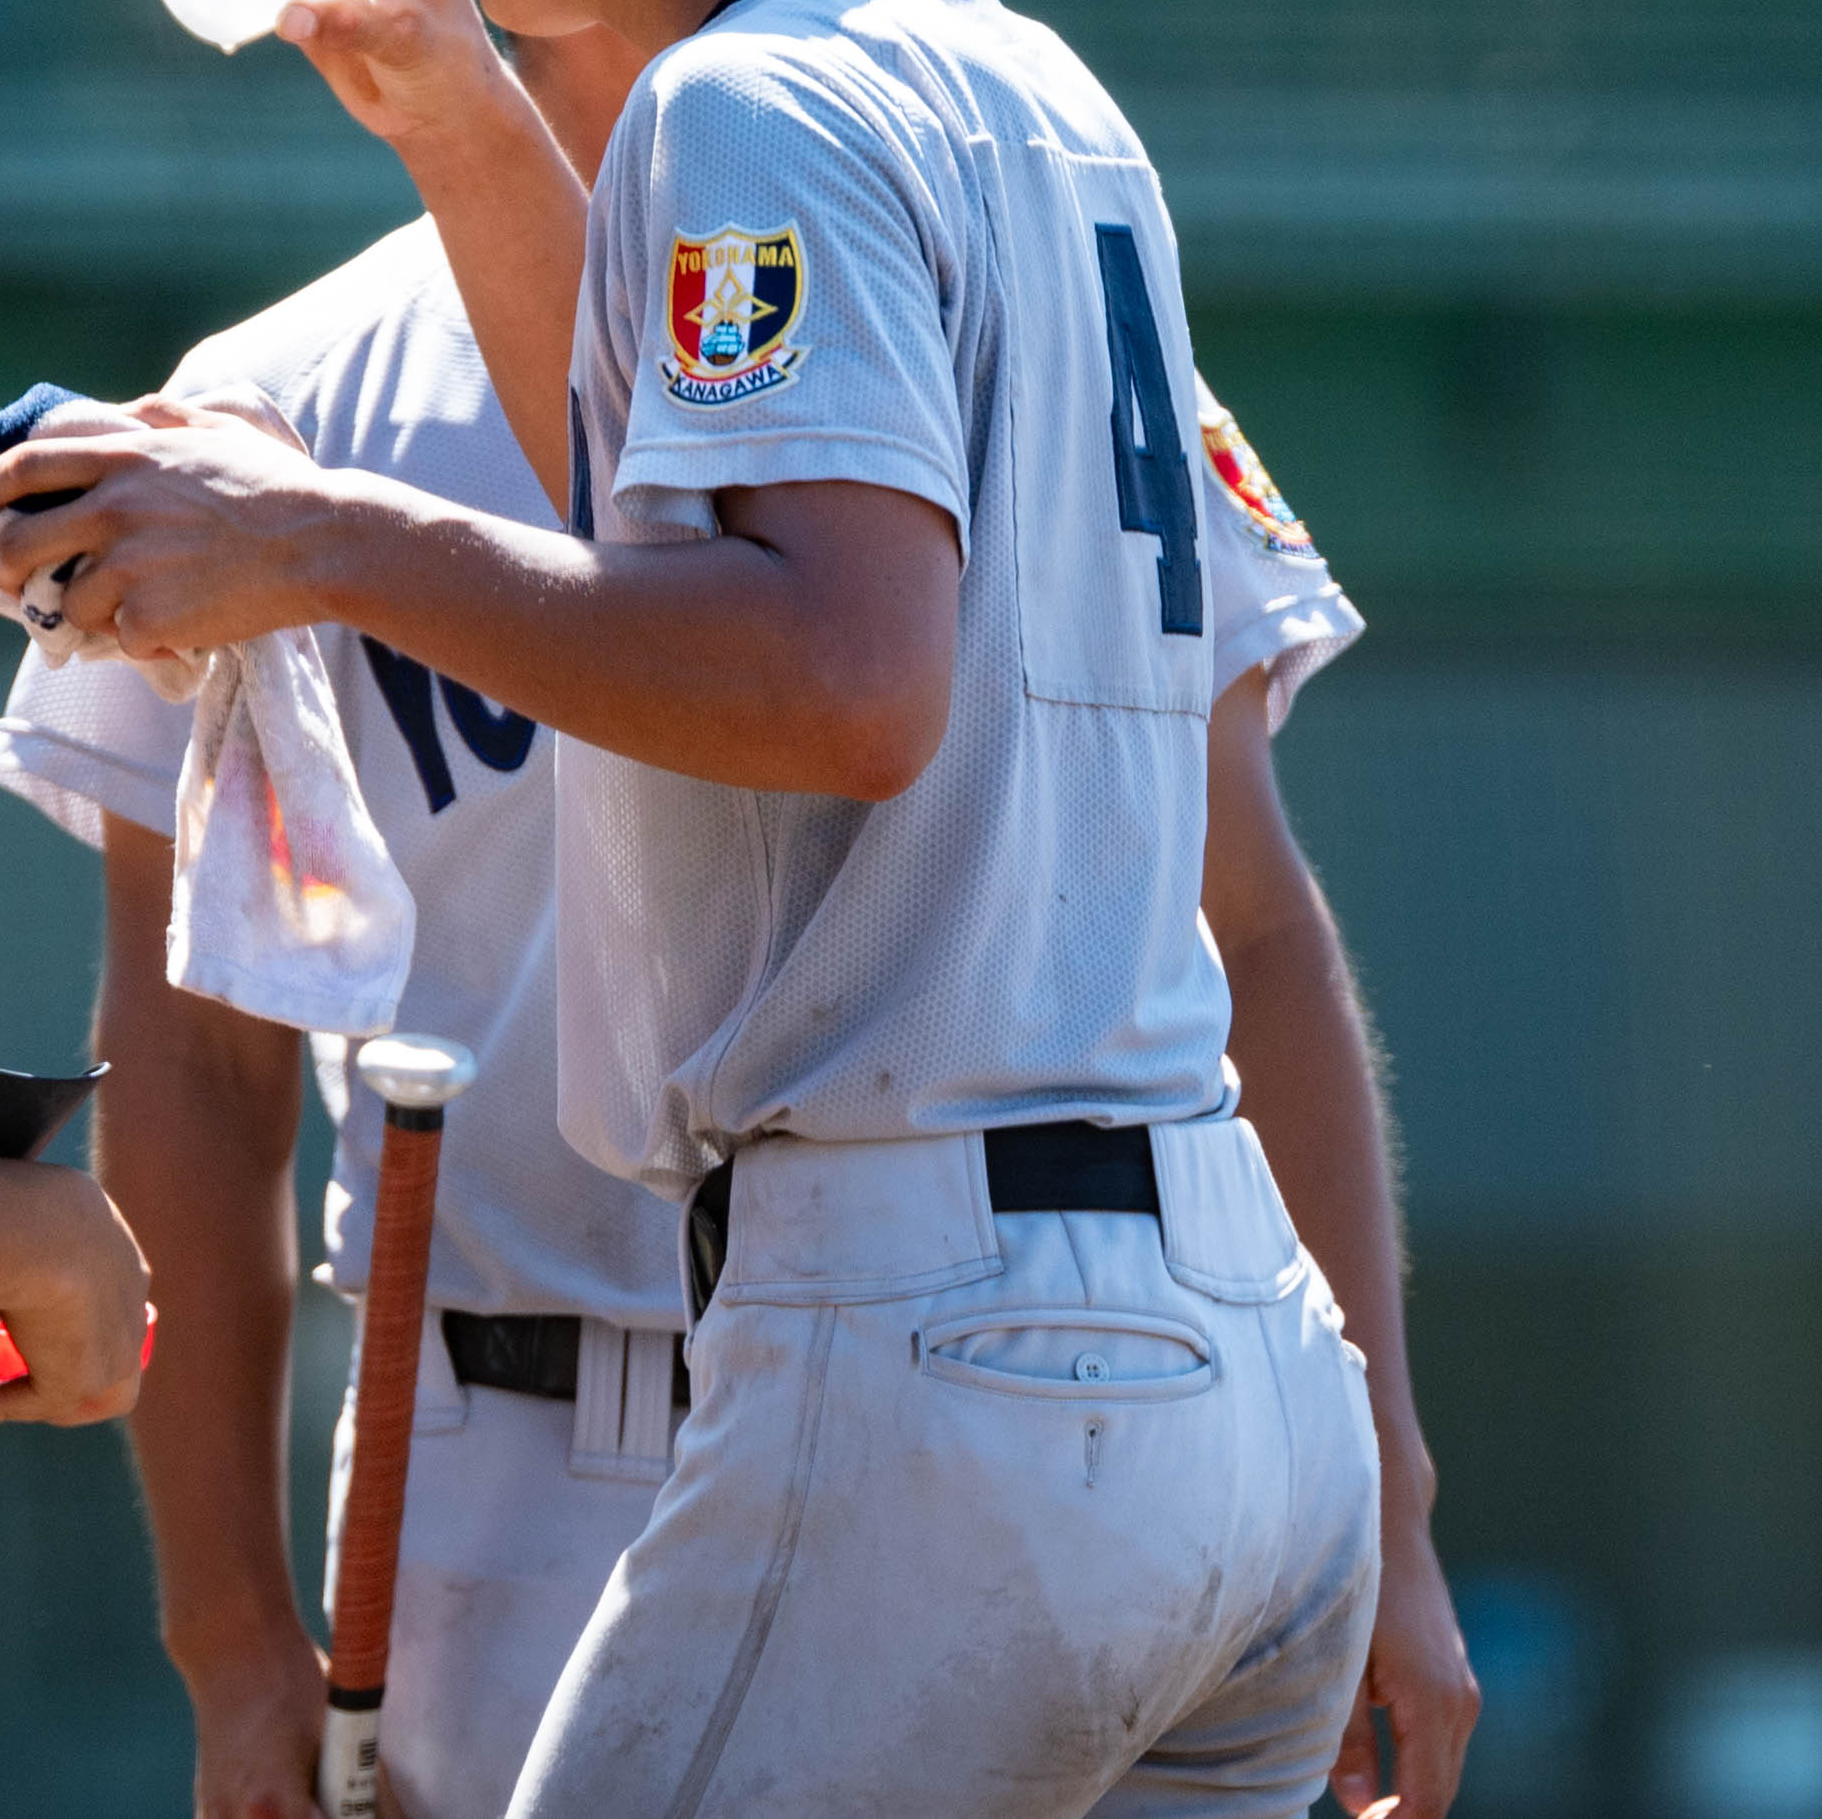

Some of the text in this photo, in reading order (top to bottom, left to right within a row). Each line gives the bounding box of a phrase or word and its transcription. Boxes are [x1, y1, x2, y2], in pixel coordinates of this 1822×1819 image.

[678, 245, 795, 275] YOKOHAMA
[672, 363, 782, 400] KANAGAWA
[1094, 222, 1203, 636] 4
